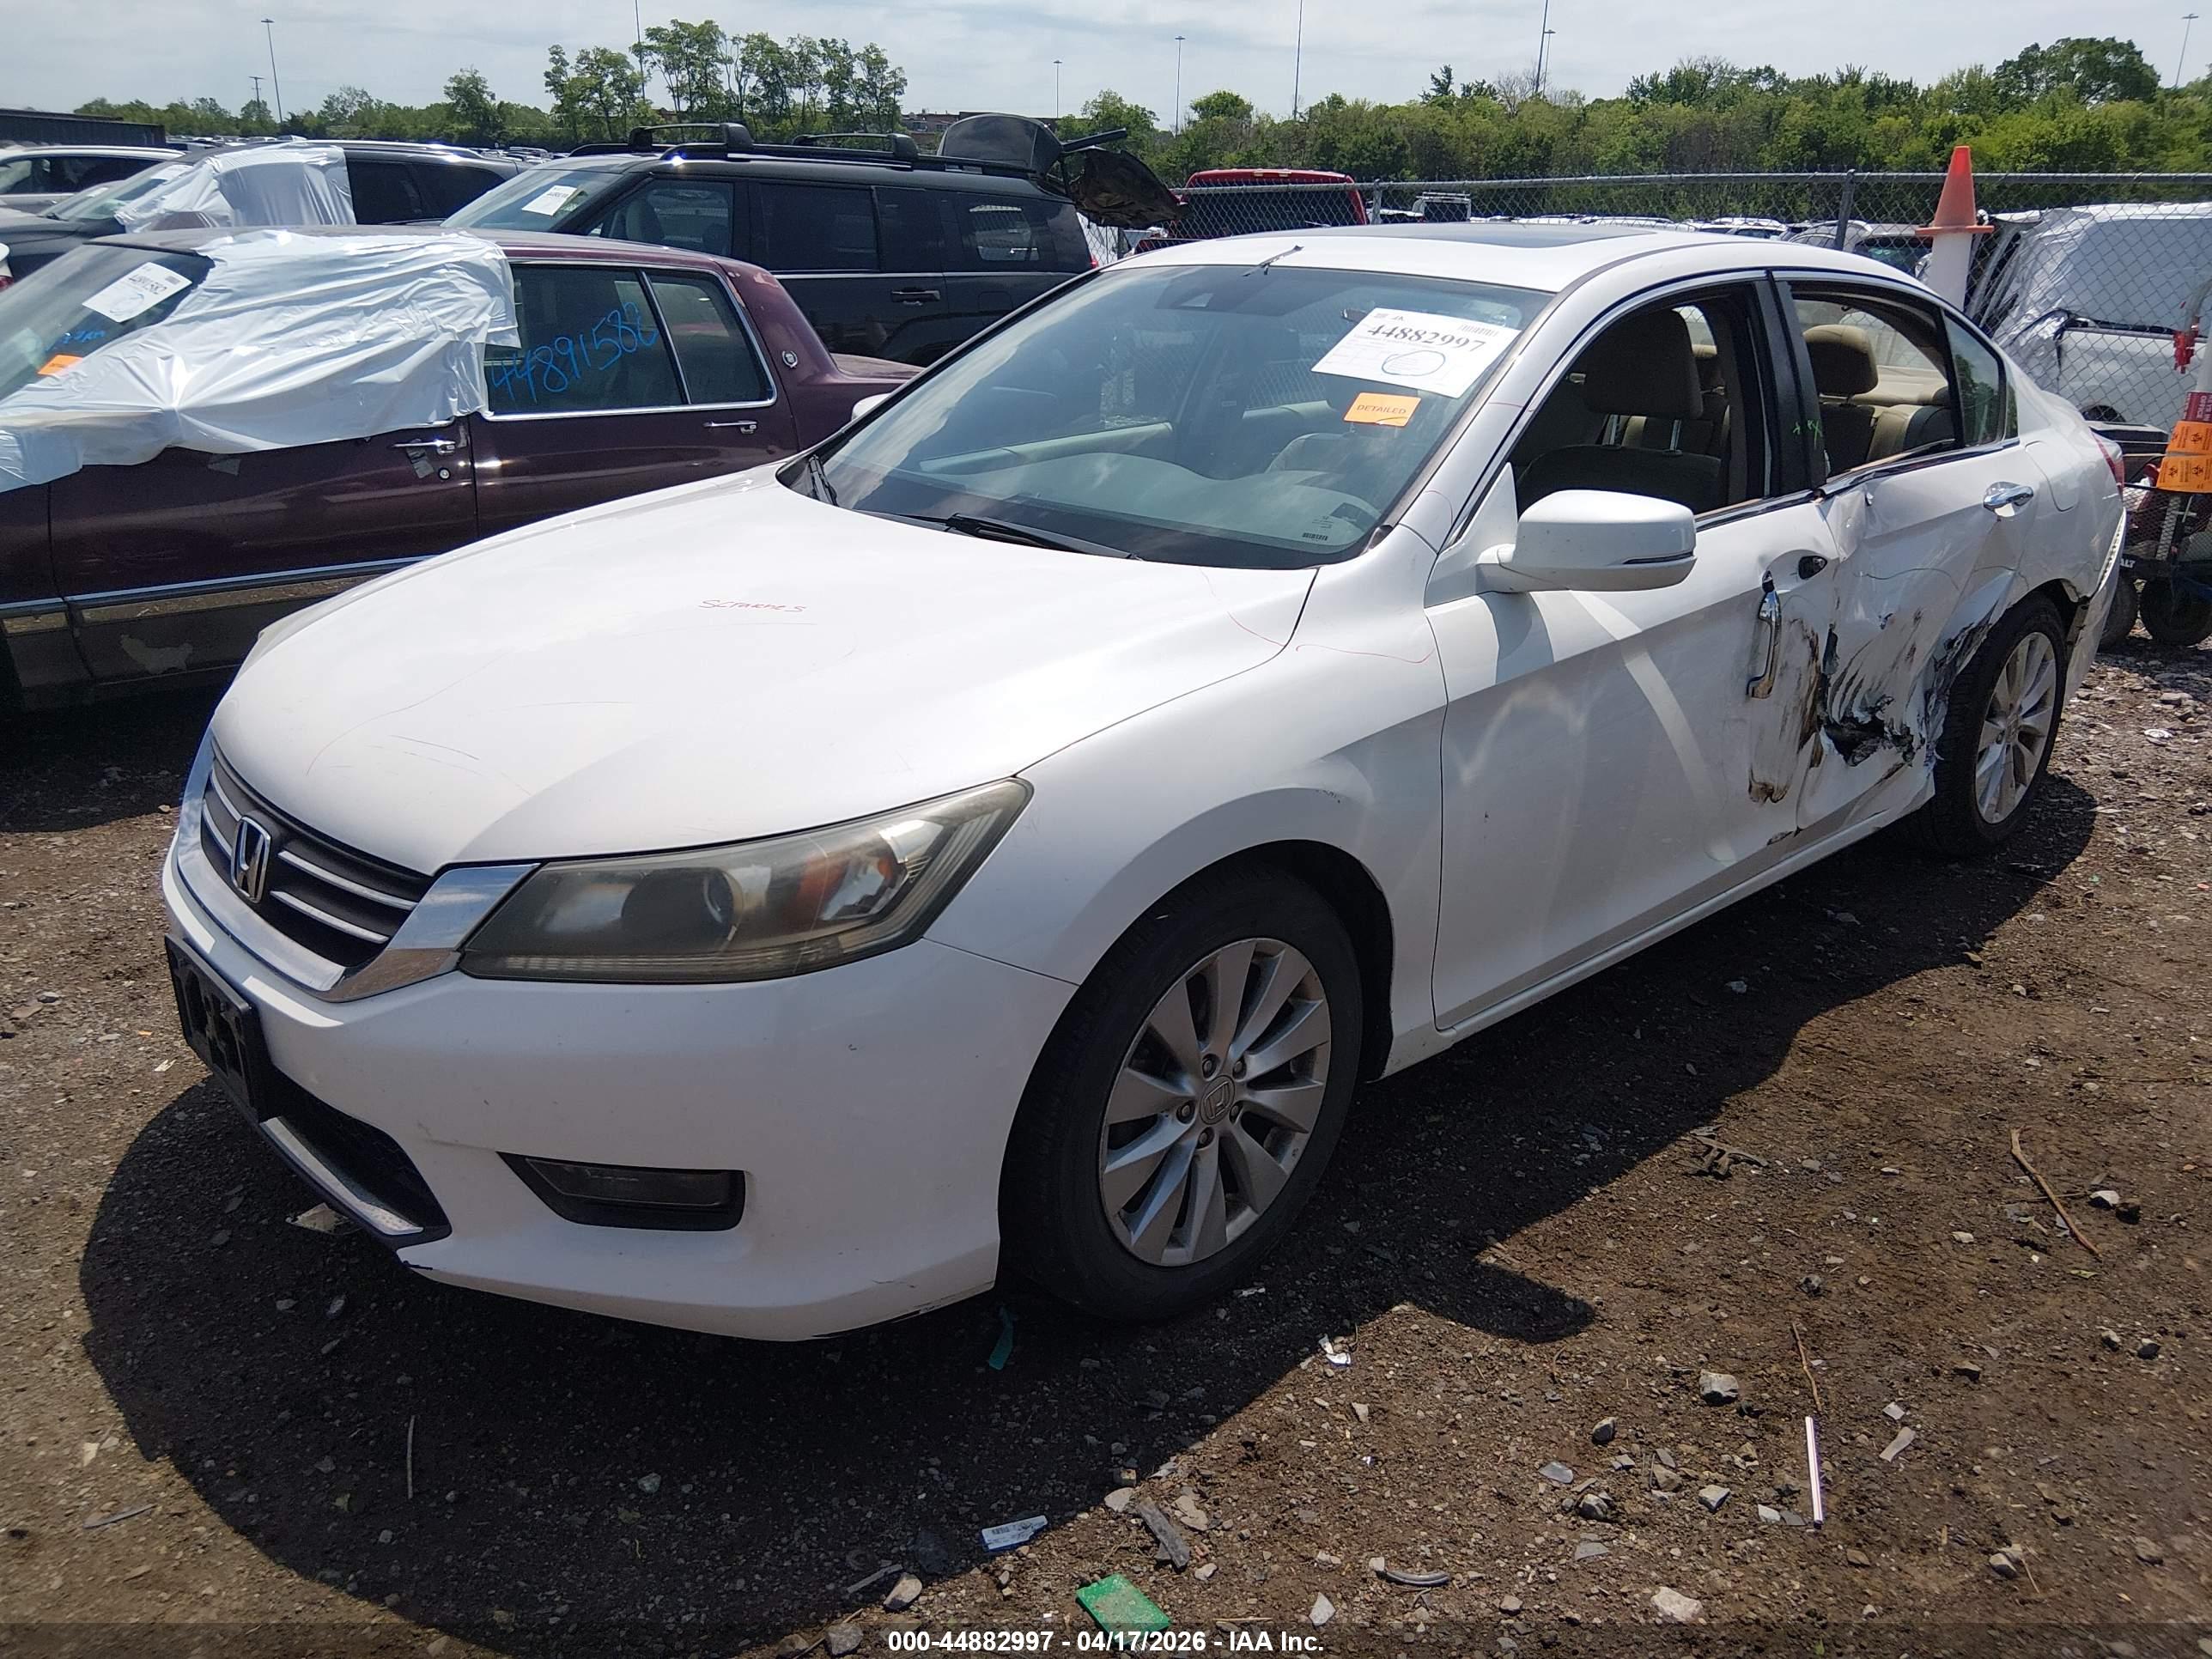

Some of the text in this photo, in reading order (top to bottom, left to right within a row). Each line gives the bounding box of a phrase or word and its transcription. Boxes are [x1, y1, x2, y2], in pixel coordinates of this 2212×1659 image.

[1367, 324, 1486, 352] 44882997
[490, 301, 659, 404] 44891582
[1356, 404, 1407, 415] DETAILED
